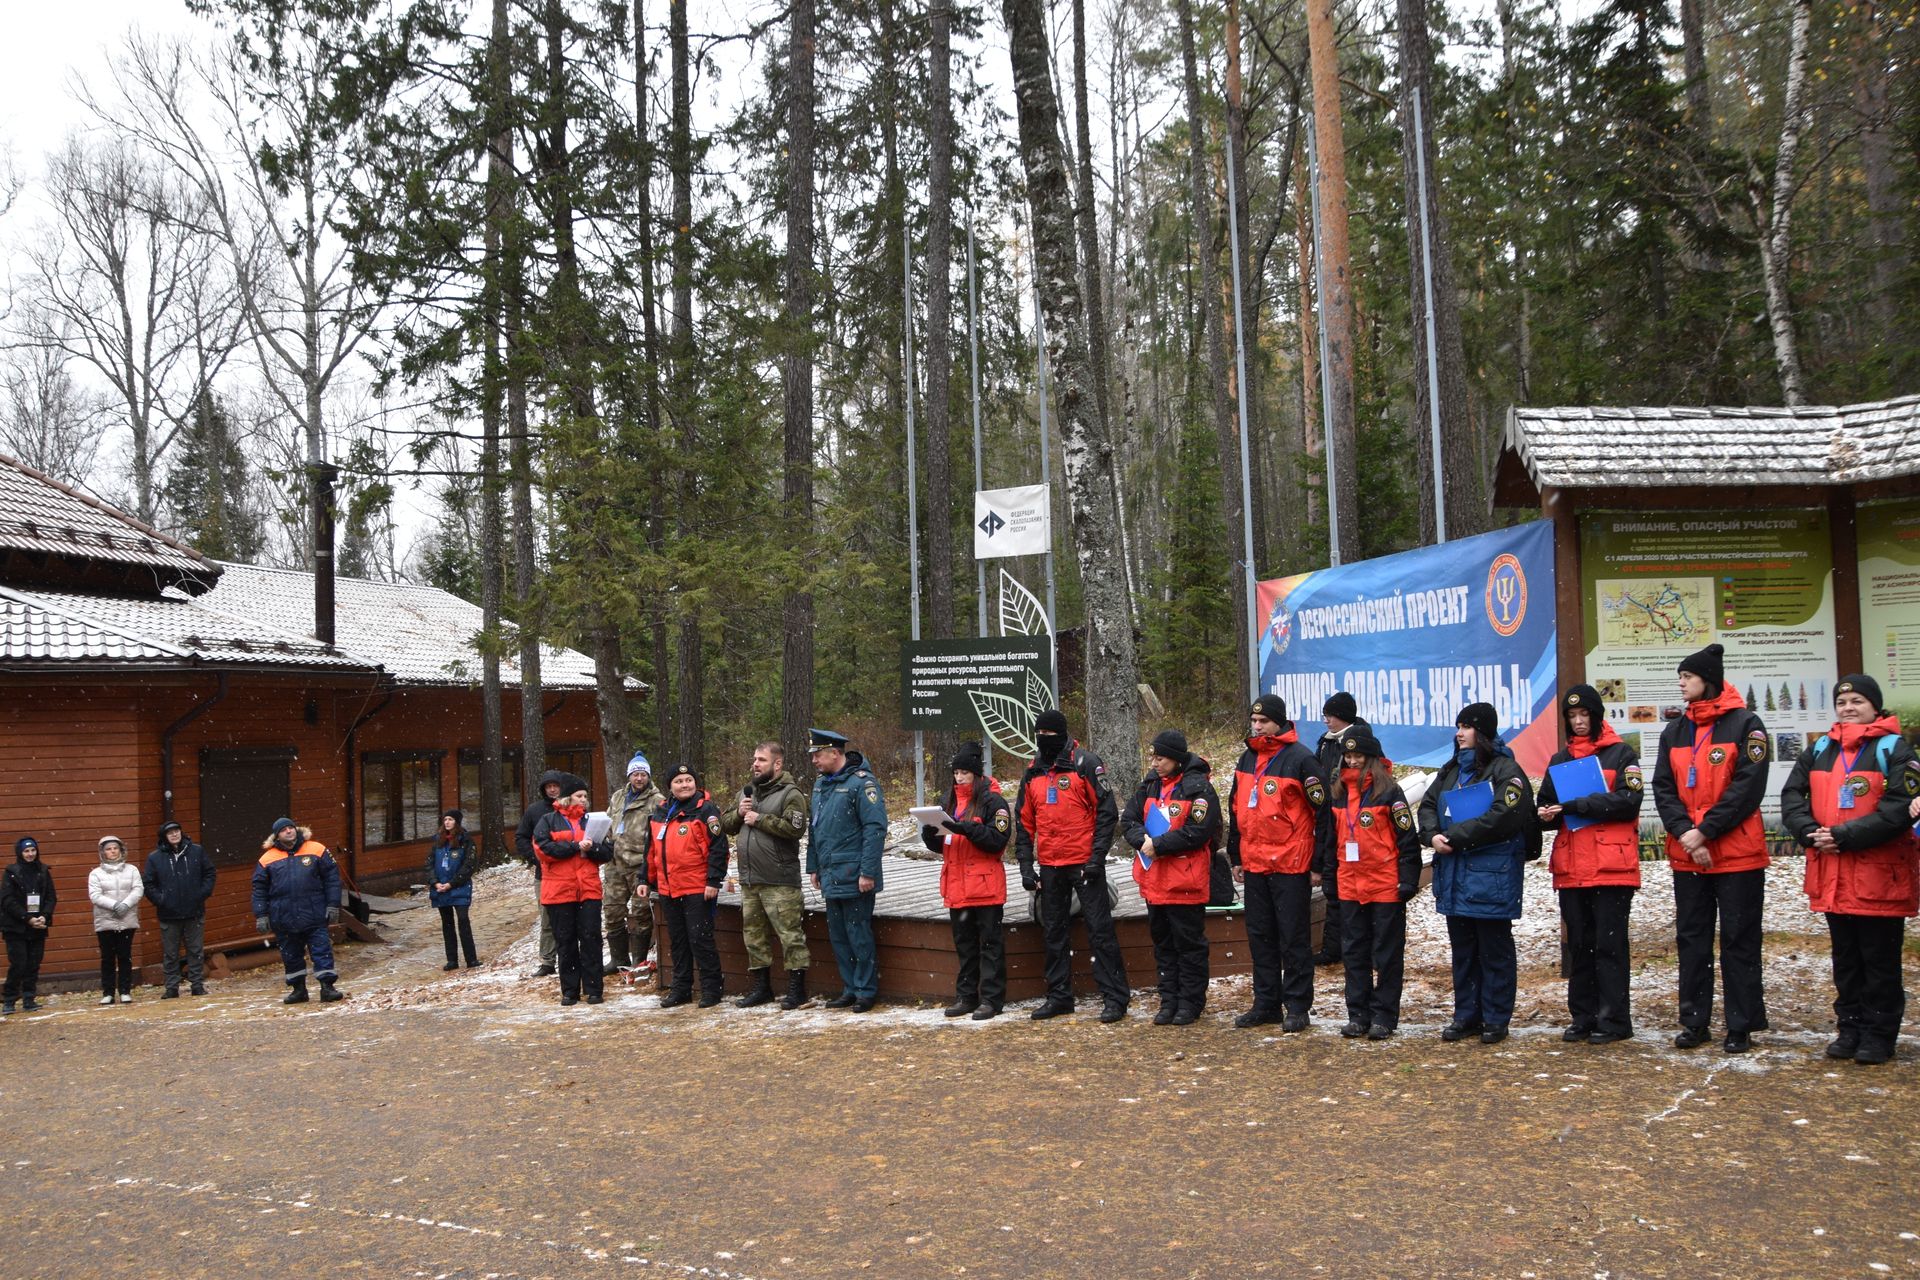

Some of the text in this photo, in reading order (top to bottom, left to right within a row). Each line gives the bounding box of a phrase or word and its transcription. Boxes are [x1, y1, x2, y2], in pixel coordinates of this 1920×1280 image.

[1612, 519, 1797, 533] ВНИМАНИЕ, ОПАСНЫЙ УЧАСТОК!
[1298, 589, 1405, 640] ВСЕРОССИЙСКИЙ
[1405, 585, 1468, 629] ПРОЕКТ
[912, 651, 1039, 664] «Важно сохранить уникальное богатство
[912, 664, 1024, 676] природных ресурсов, растительного
[952, 678, 967, 686] мира
[968, 676, 989, 685] нашей
[989, 677, 1014, 686] страны,
[912, 689, 939, 697] России»
[1271, 671, 1340, 722] НАУЧИС
[912, 707, 942, 716] В. В. Путин
